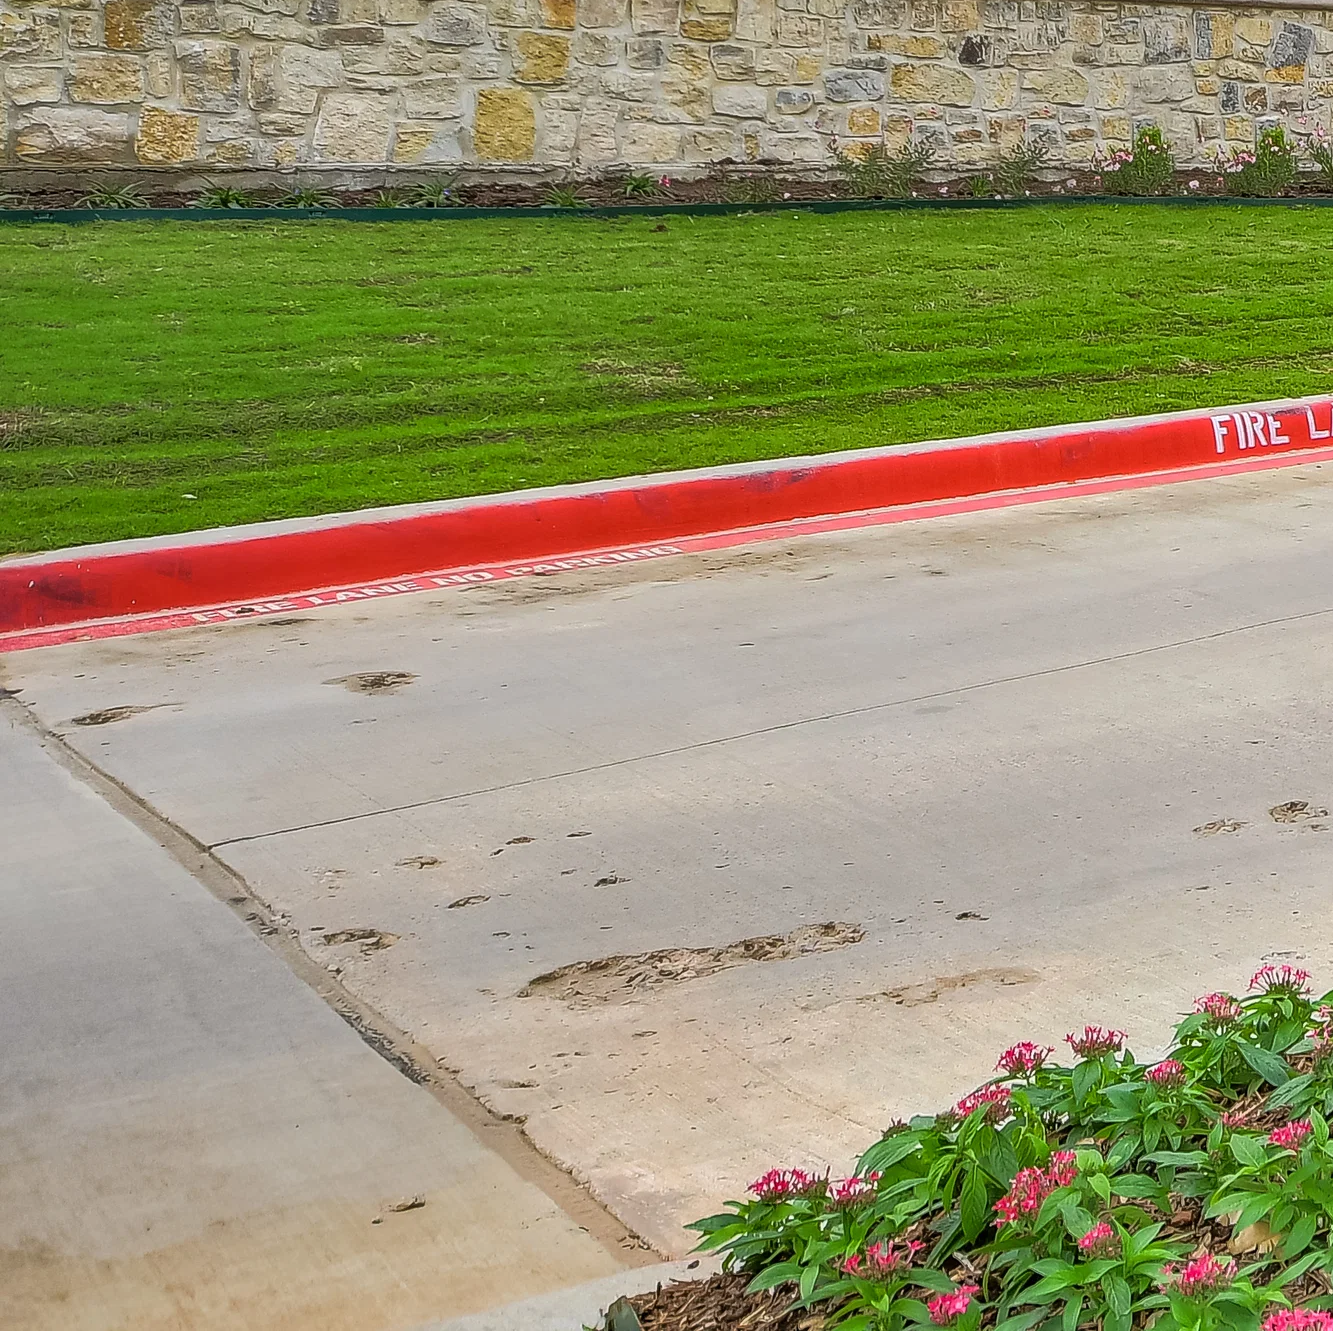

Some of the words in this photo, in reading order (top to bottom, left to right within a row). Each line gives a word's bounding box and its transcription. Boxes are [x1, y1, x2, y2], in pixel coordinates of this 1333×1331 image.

[1210, 409, 1291, 454] FIRE
[306, 580, 424, 606] LANE
[430, 570, 494, 586] NO
[504, 545, 684, 576] PARKING
